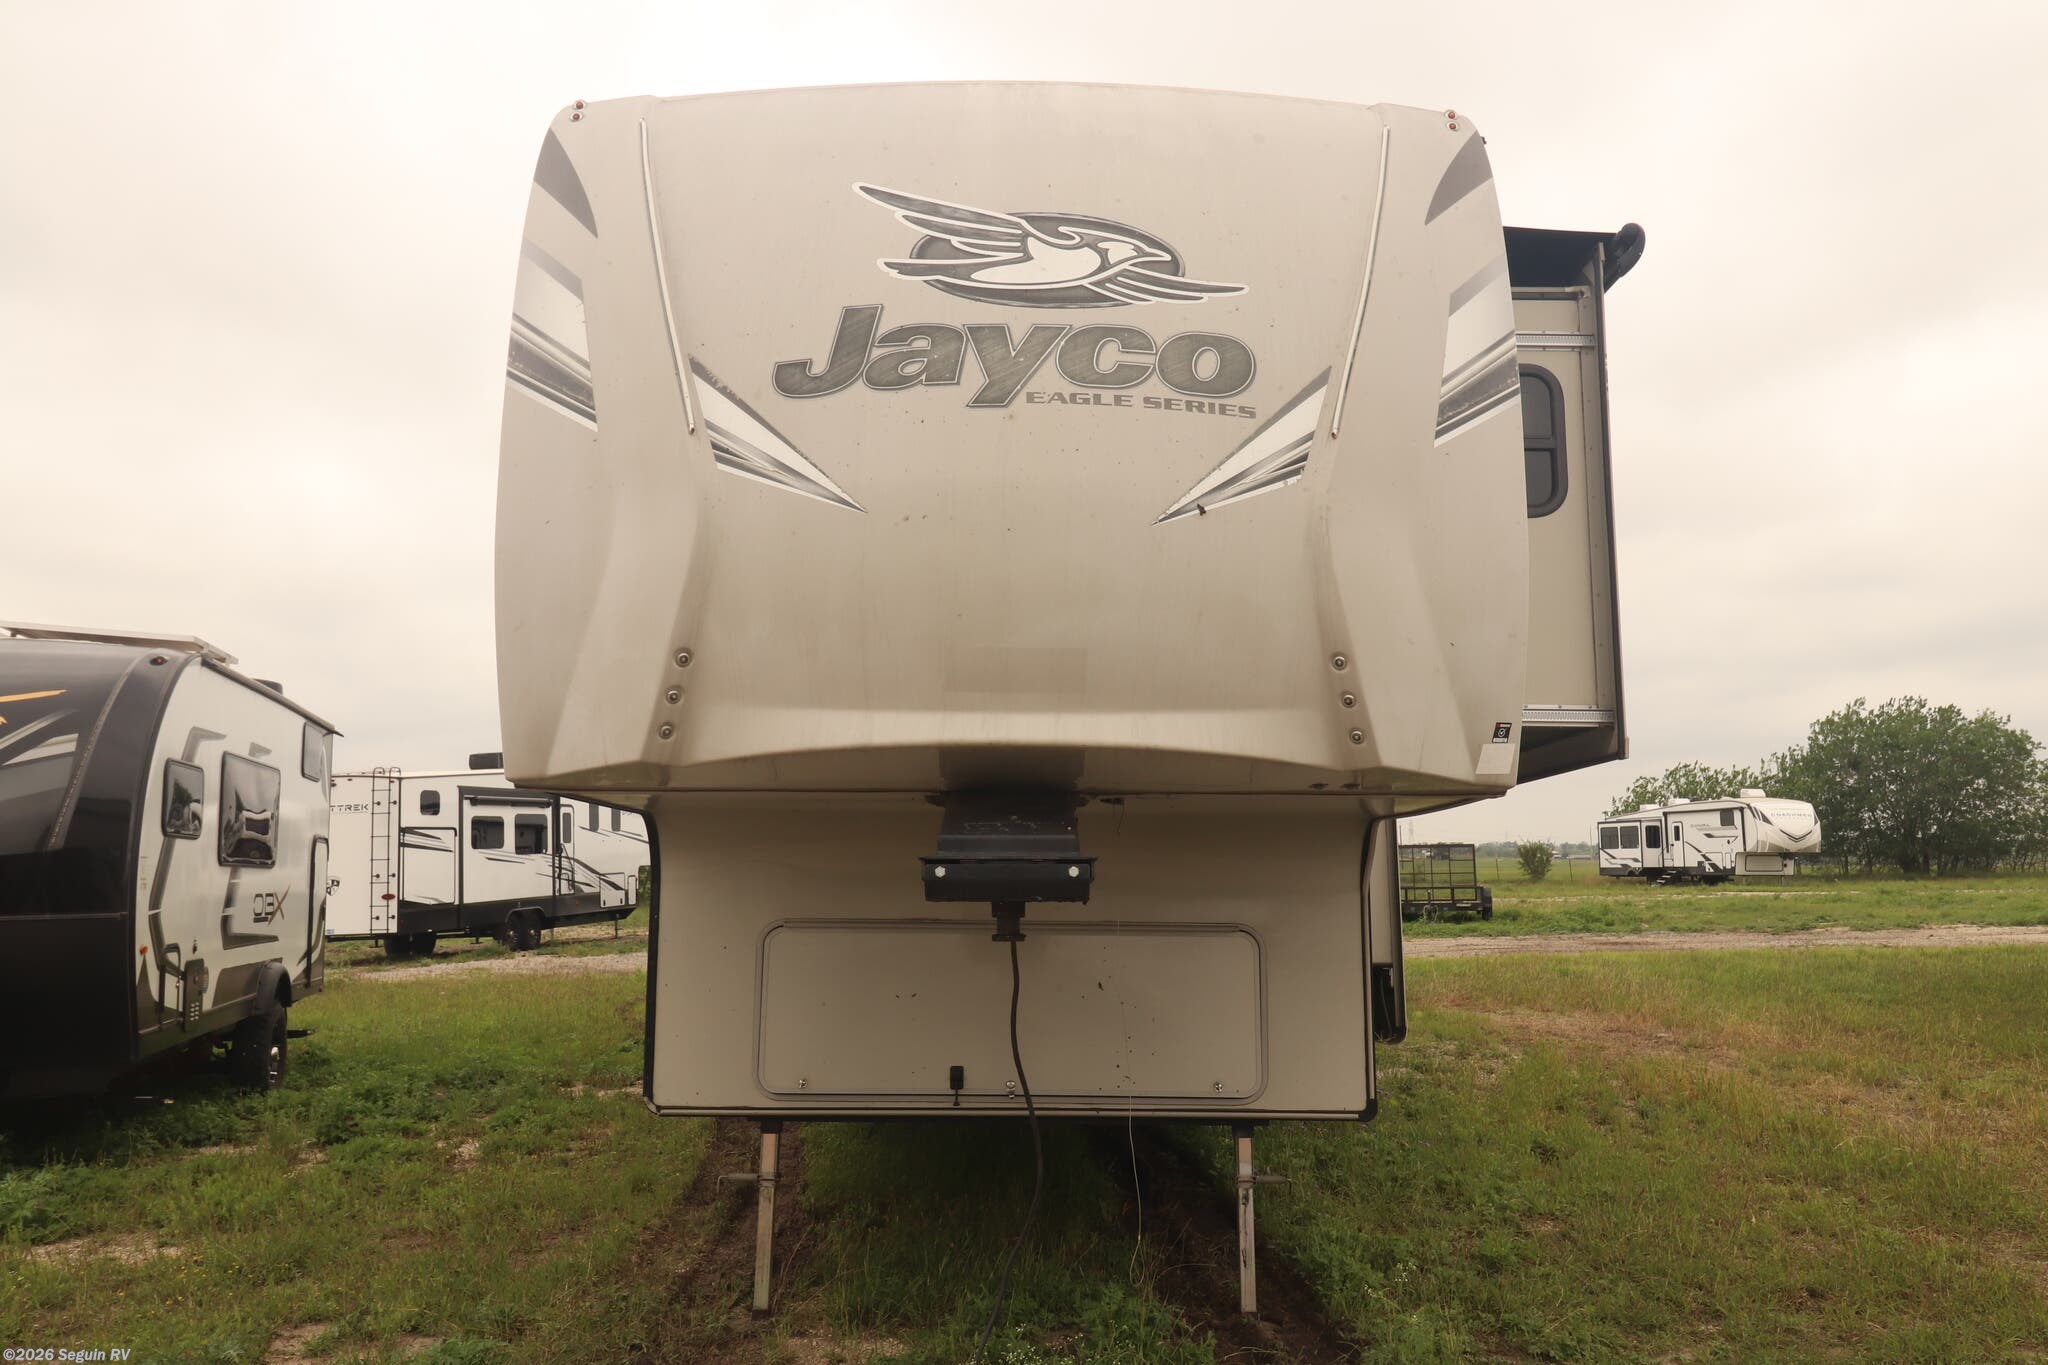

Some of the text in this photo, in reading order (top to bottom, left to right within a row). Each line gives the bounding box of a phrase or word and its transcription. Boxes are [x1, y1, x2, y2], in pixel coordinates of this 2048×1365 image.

[772, 304, 1256, 408] Jayco
[1026, 391, 1257, 419] EAGLE SERIES
[253, 885, 290, 925] OBX
